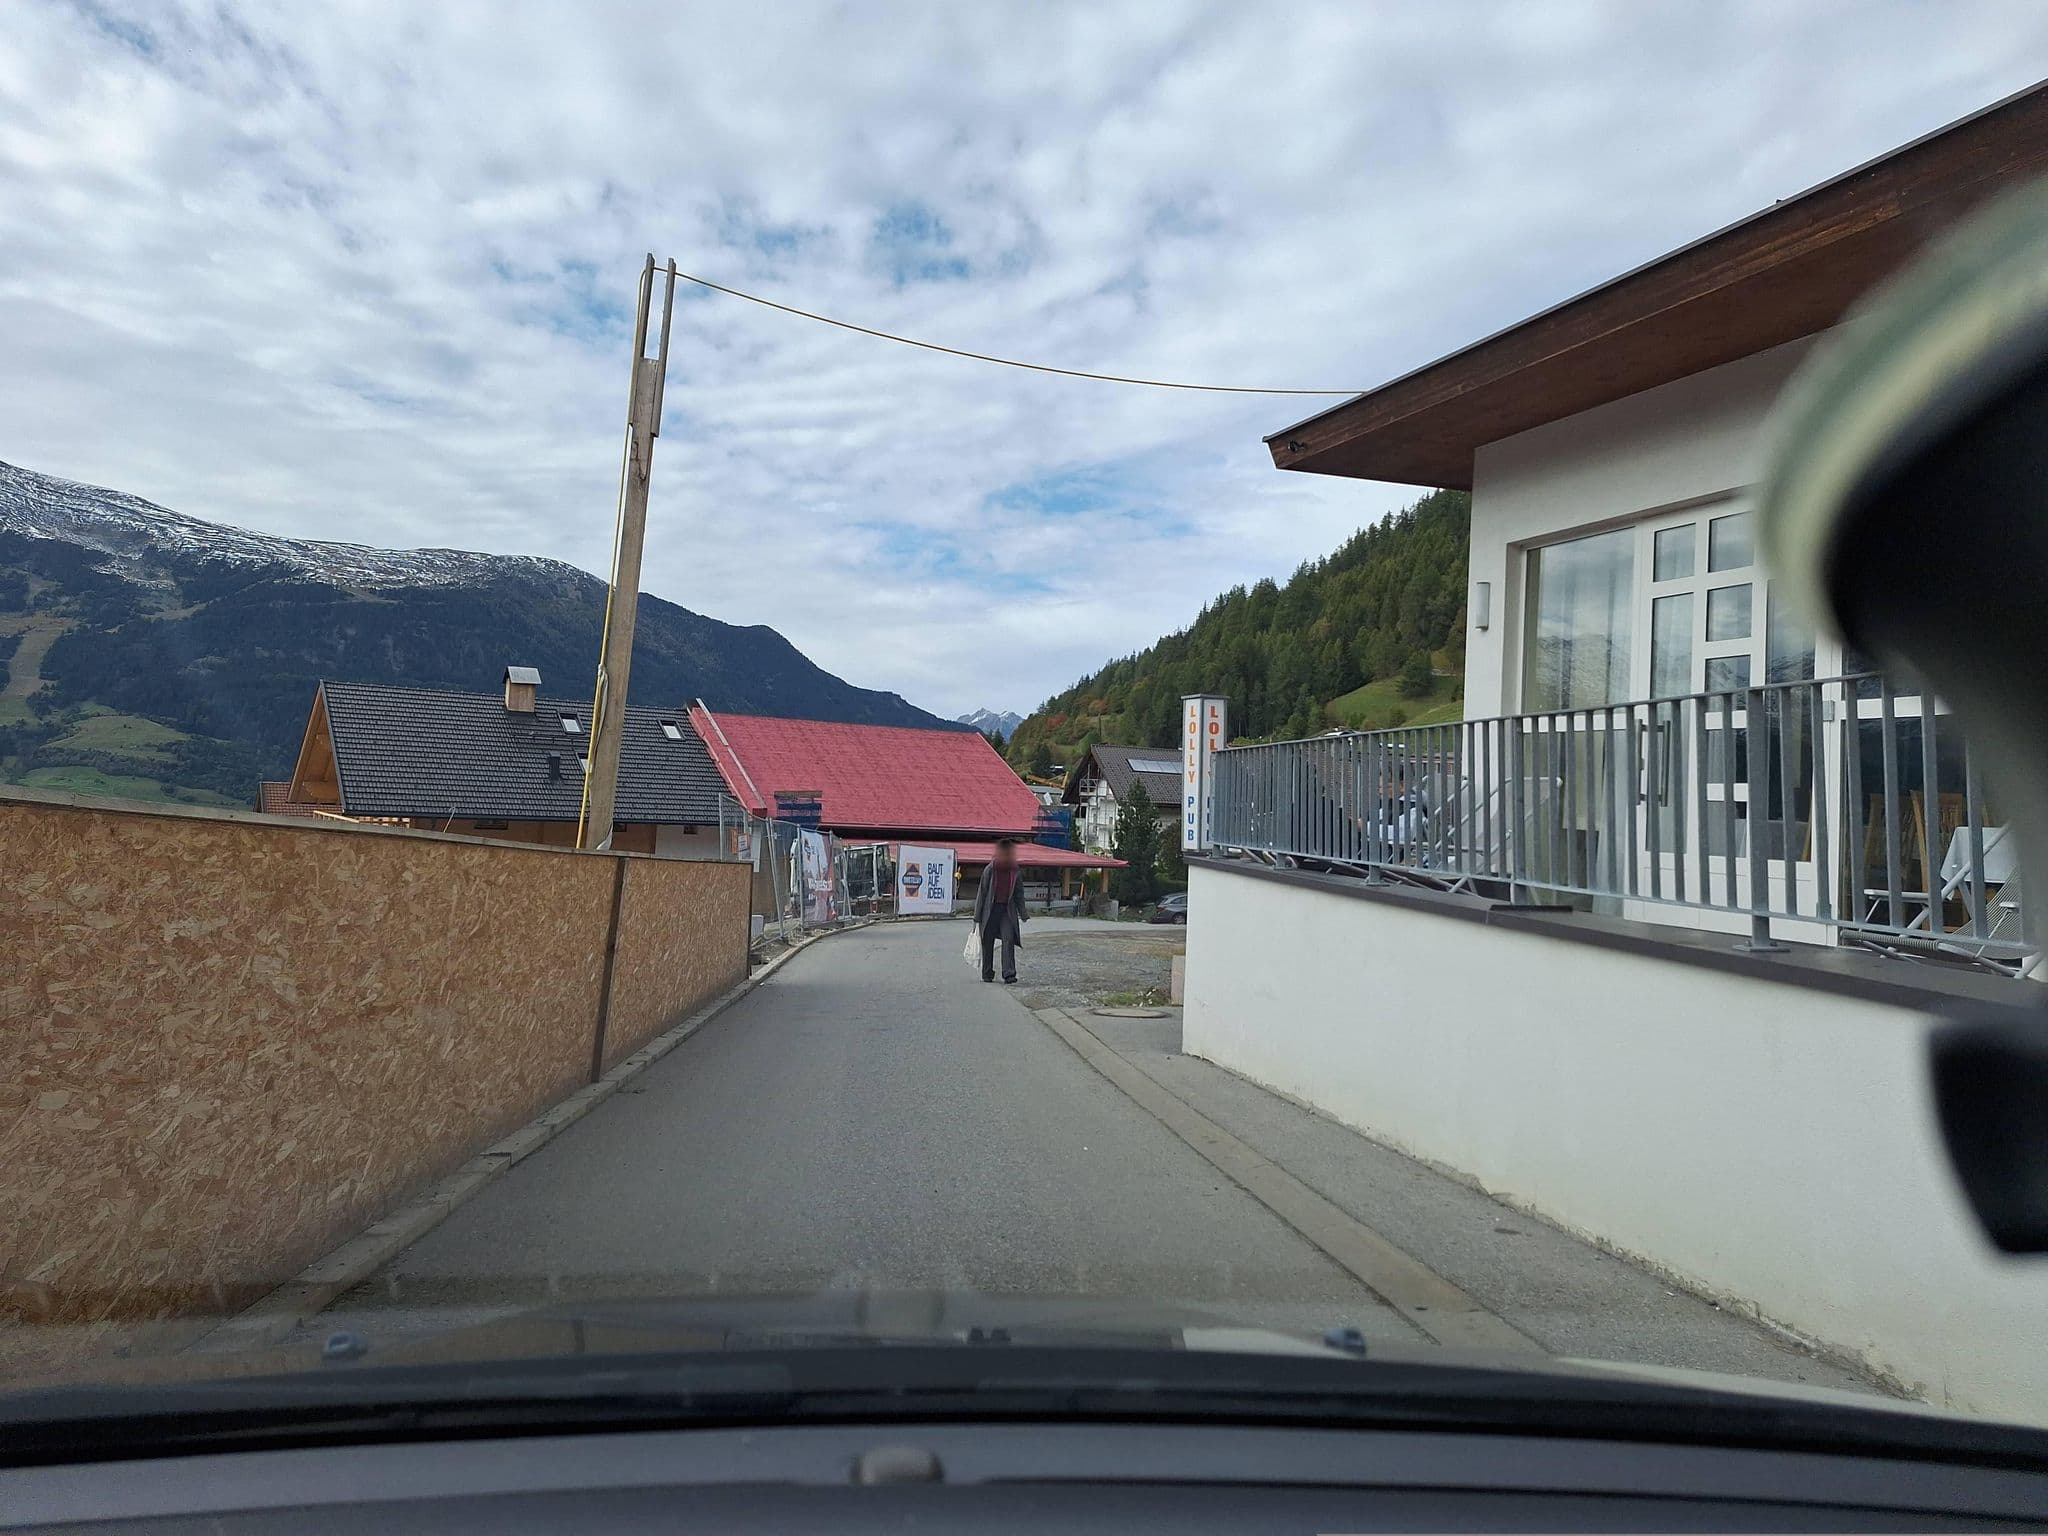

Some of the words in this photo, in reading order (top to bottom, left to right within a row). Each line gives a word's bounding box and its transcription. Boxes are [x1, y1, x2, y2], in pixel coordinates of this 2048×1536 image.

[1208, 705, 1219, 752] LOL
[1187, 705, 1197, 784] LOLLY
[1187, 796, 1195, 841] PUB
[927, 863, 944, 875] BAUT
[927, 875, 940, 887] AUF
[927, 887, 945, 899] IDEEN
